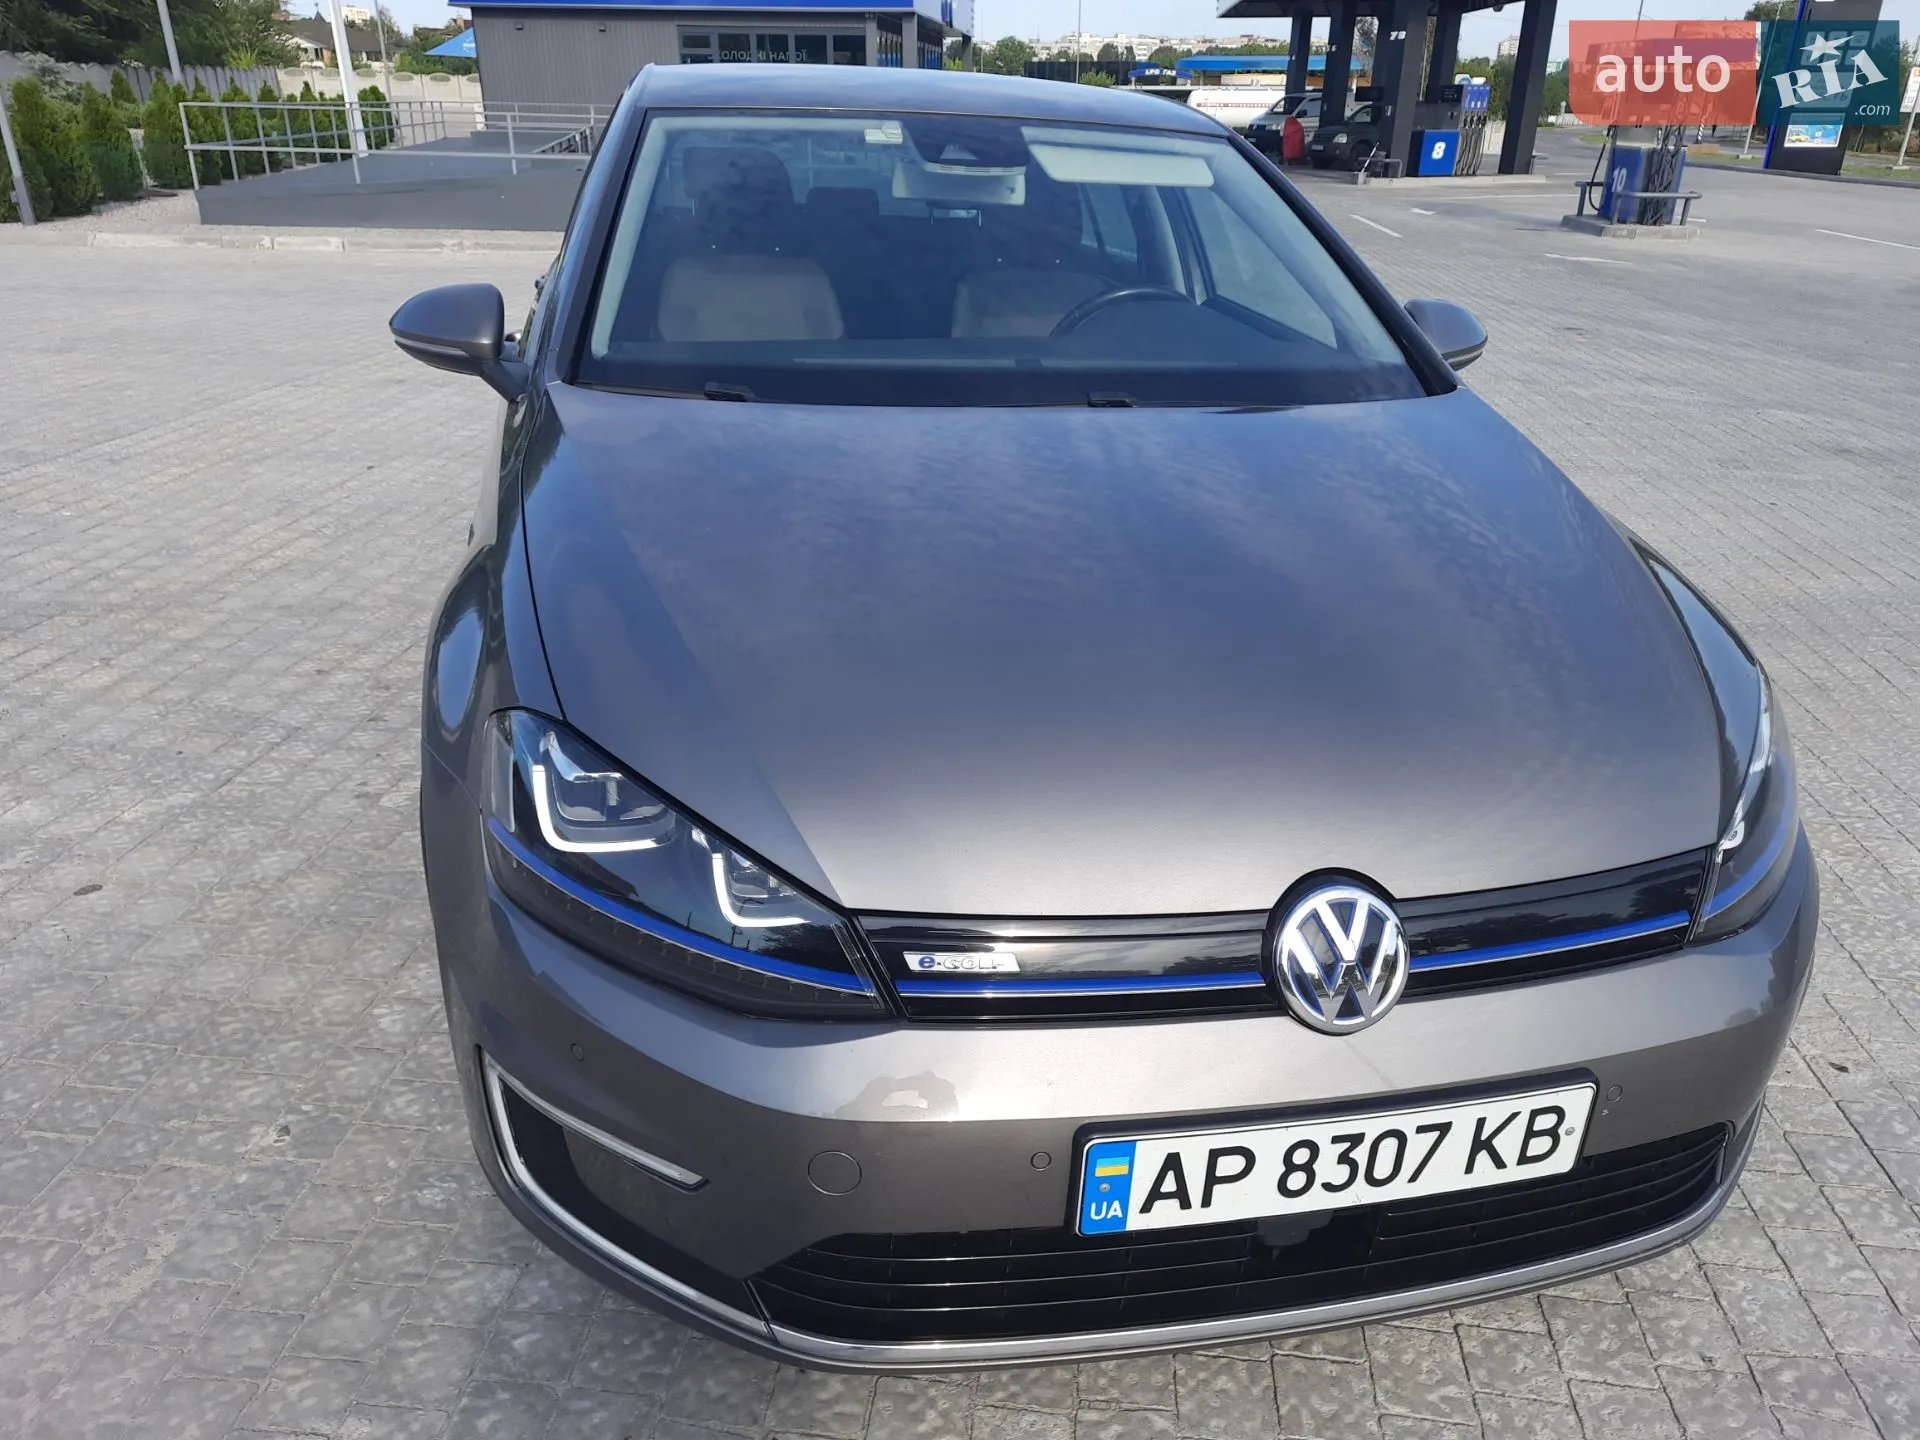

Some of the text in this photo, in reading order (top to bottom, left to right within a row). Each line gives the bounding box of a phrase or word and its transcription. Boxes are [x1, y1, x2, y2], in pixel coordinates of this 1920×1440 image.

[1431, 141, 1447, 160] 8
[1612, 167, 1628, 193] 10
[1139, 1104, 1567, 1214] AP 8307 KB
[1089, 1200, 1123, 1222] UA
